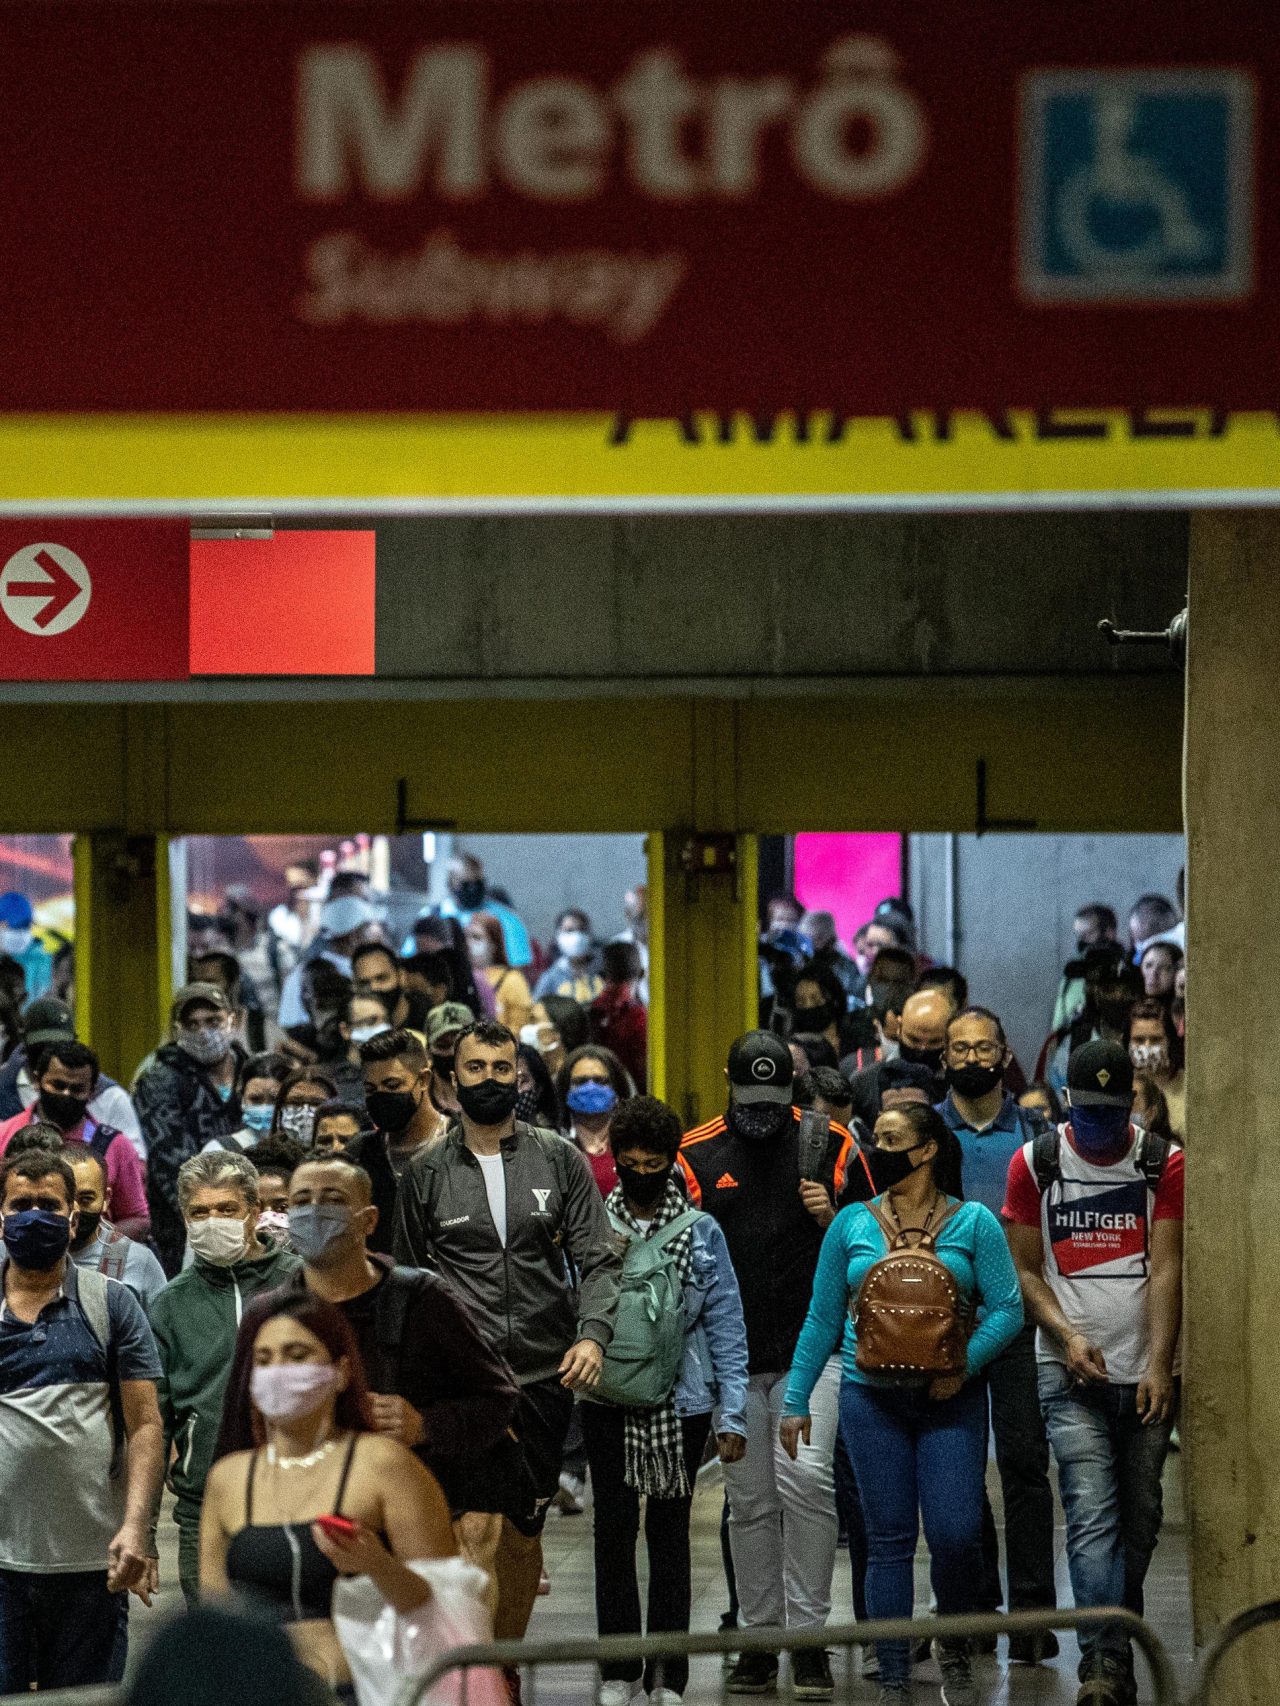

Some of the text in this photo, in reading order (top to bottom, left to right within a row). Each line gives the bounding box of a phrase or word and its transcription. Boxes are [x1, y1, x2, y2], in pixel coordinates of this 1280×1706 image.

[296, 34, 927, 199] Metrô
[302, 232, 682, 340] Subway
[1055, 1210, 1138, 1231] HILFIGER
[1071, 1231, 1122, 1242] NEW YORK
